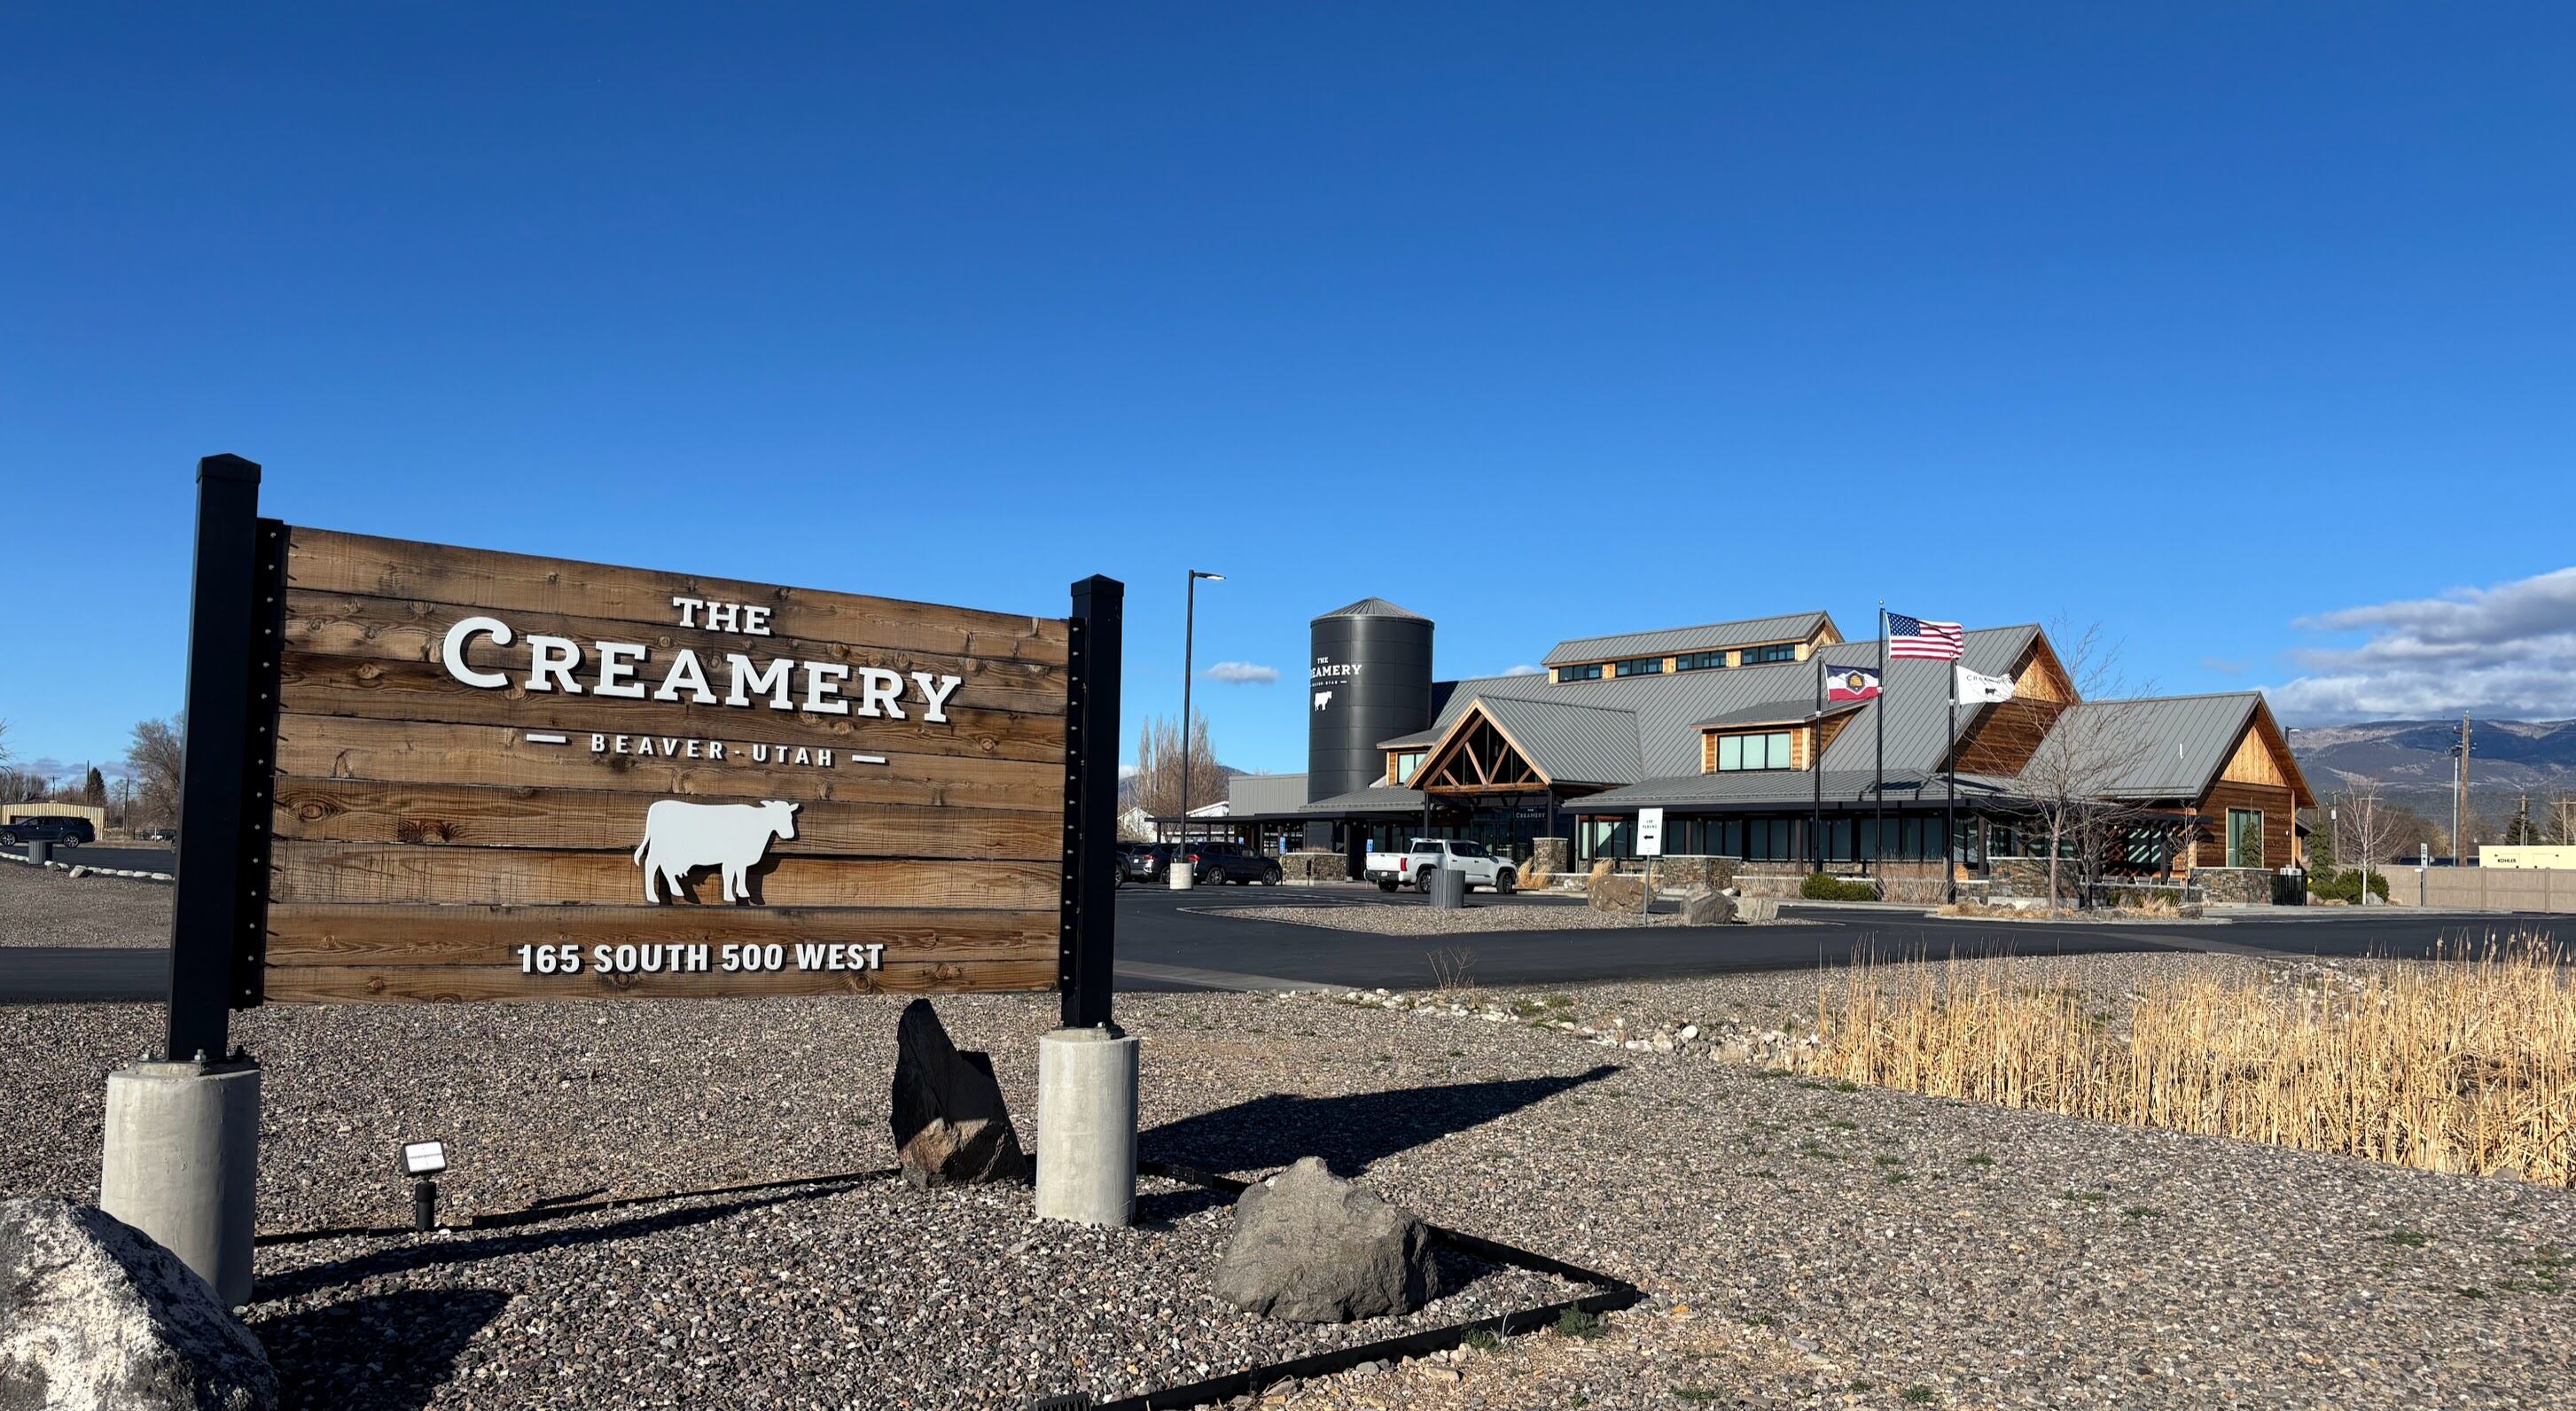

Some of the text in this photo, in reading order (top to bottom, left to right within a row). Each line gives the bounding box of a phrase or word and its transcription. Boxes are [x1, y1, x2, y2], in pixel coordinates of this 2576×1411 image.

[672, 596, 772, 635] THE
[442, 616, 962, 723] CREAMERY
[1310, 665, 1362, 678] EAMERY
[517, 944, 884, 973] 165 SOUTH 500 WEST
